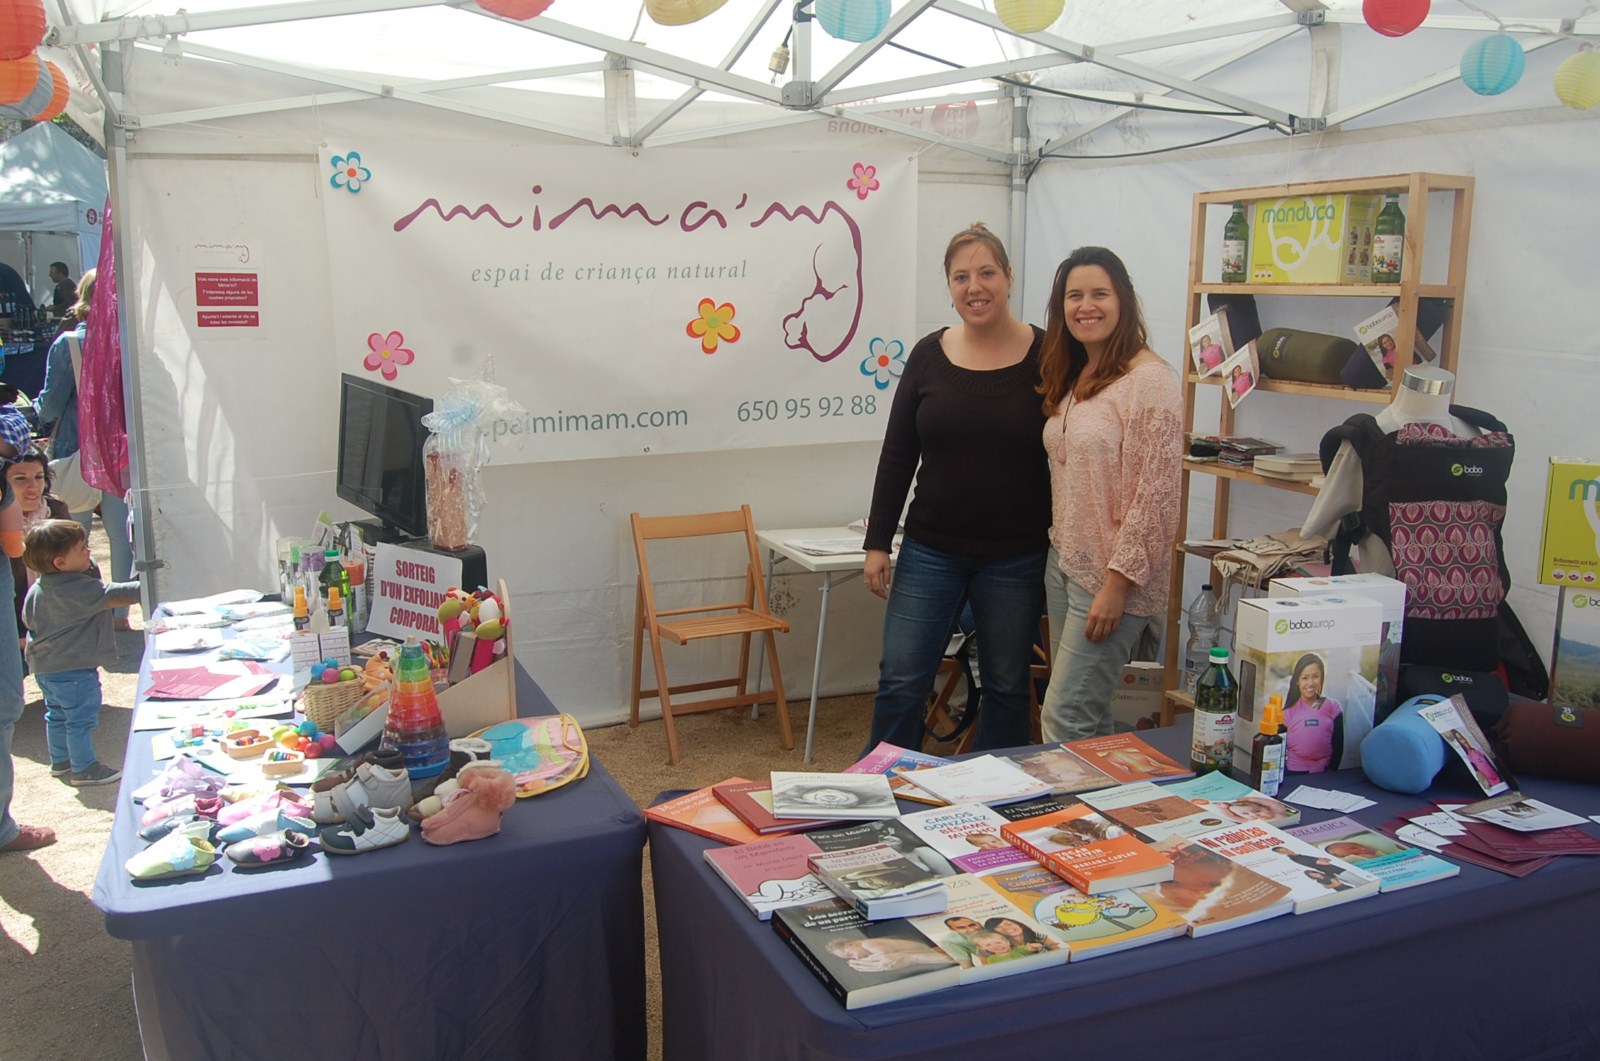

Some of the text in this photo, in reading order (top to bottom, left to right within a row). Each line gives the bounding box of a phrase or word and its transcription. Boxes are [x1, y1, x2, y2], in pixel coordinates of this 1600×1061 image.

[1262, 201, 1336, 224] manduca
[471, 259, 748, 288] espai de criança natural
[736, 394, 877, 422] 650 95 92 88
[1464, 464, 1483, 474] boba
[396, 560, 436, 584] SORTEIG
[380, 580, 447, 610] D'UN EXFOLIAN
[390, 606, 440, 634] CORPORAL
[1289, 618, 1336, 631] bobawrap
[925, 811, 974, 824] CARLOS
[948, 827, 998, 841] MUCHO
[1198, 826, 1268, 850] Ni rabietas
[1002, 830, 1021, 847] TOCAR
[1030, 848, 1048, 863] VIVIR
[1054, 847, 1089, 858] TOCAR
[1218, 836, 1286, 858] ni conflictos
[804, 920, 817, 928] de
[818, 918, 832, 926] un
[832, 914, 860, 924] parto
[807, 912, 827, 921] Los
